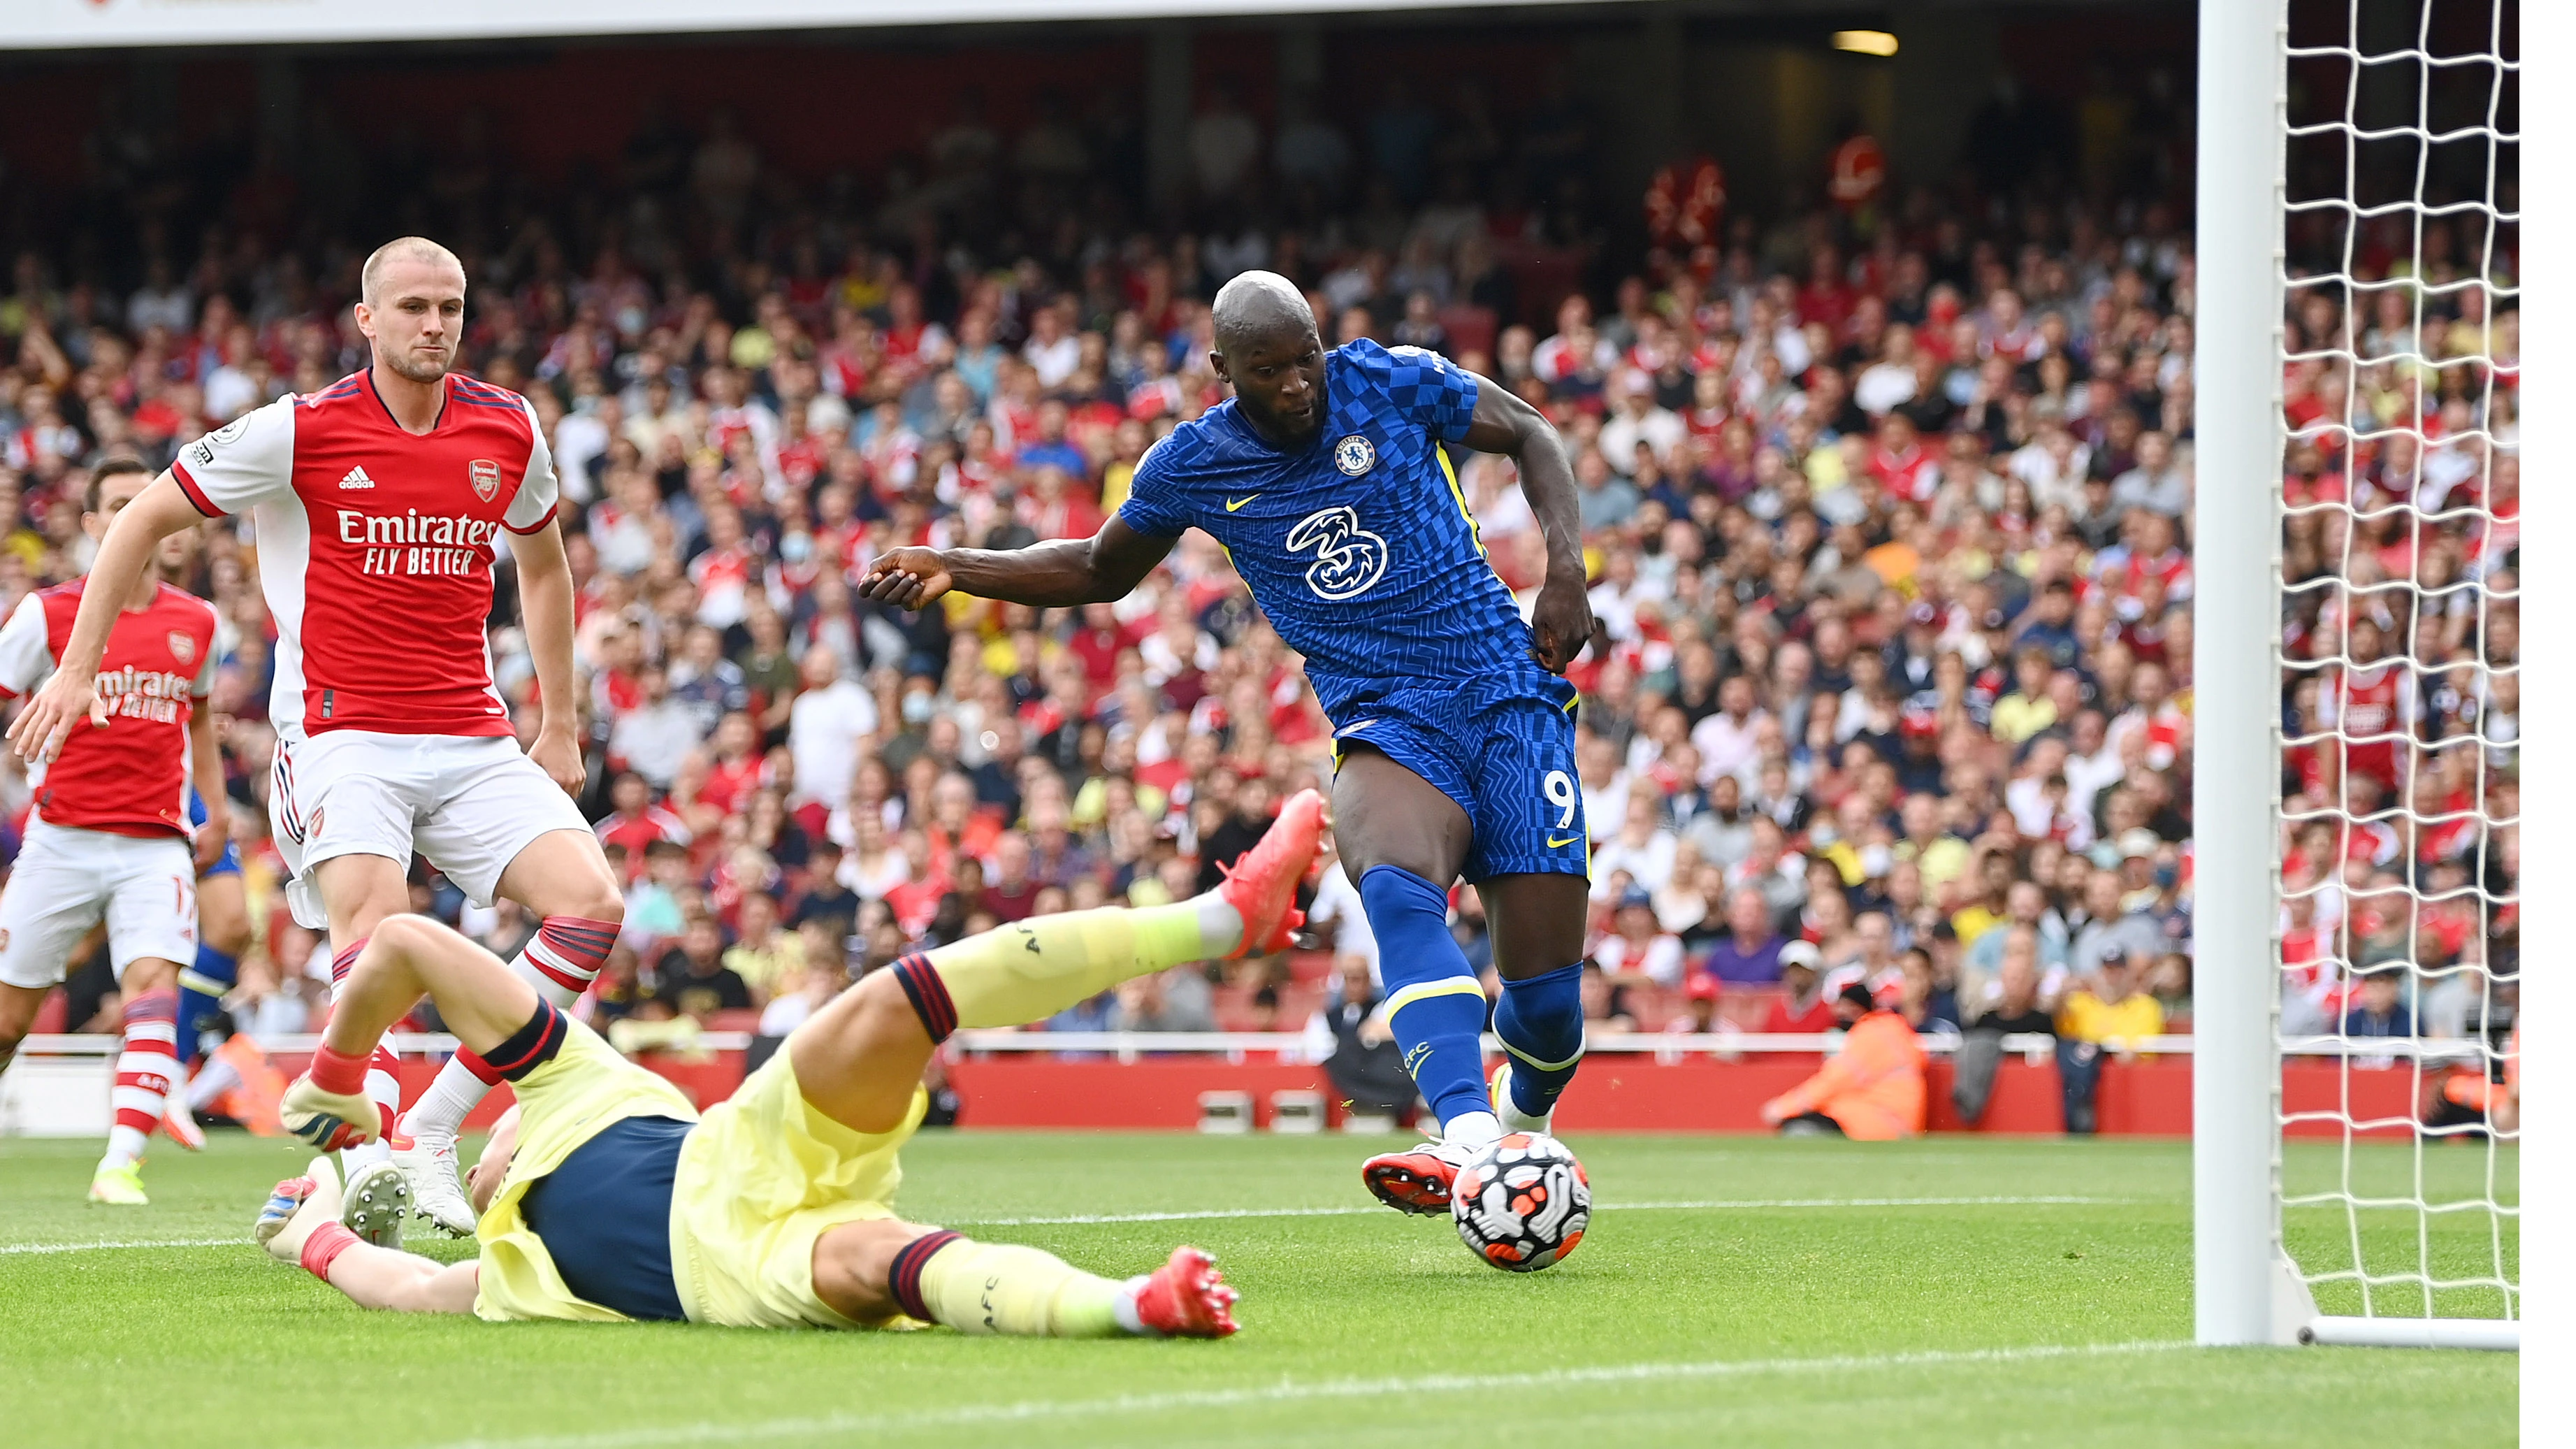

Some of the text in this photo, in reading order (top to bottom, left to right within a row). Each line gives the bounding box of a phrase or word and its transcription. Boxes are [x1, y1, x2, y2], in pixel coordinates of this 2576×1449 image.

[338, 480, 375, 489] adidas
[337, 508, 496, 546] Emirates
[363, 547, 475, 575] FLY BETTER
[1286, 505, 1388, 600] 3
[1543, 770, 1575, 829] 9
[1403, 1041, 1430, 1069] CFC
[981, 1275, 1000, 1334] AFC
